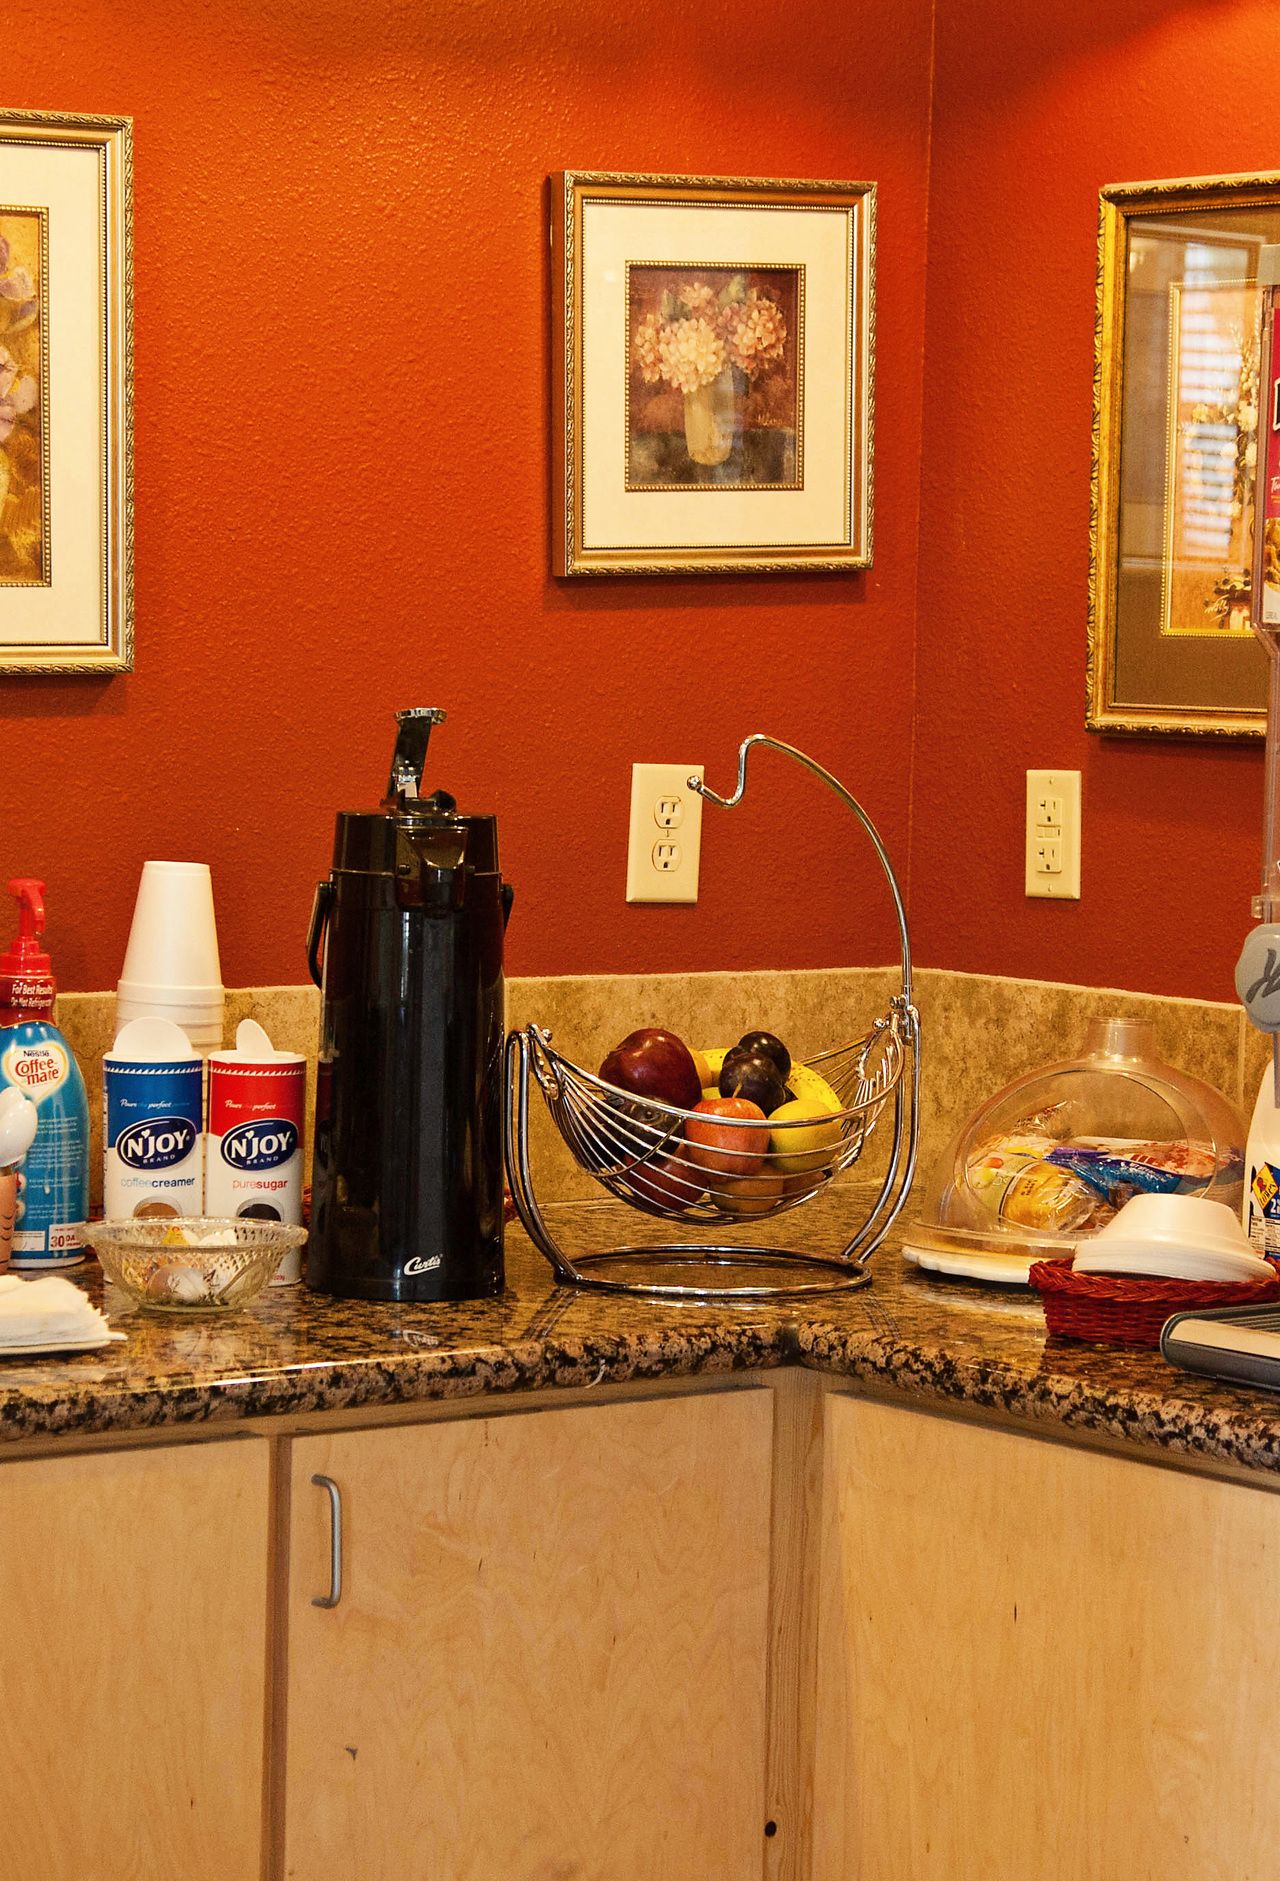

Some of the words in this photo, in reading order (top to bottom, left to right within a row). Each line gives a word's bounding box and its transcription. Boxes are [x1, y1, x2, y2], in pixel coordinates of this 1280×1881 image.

[27, 1067, 59, 1086] mate
[120, 1097, 138, 1108] Pours
[147, 1100, 173, 1111] perfect
[225, 1099, 242, 1109] Pours
[252, 1101, 277, 1112] perfect
[142, 1153, 176, 1165] BRAND
[246, 1155, 279, 1166] BRAND
[50, 1235, 65, 1247] 30
[403, 1256, 441, 1276] Curtis
